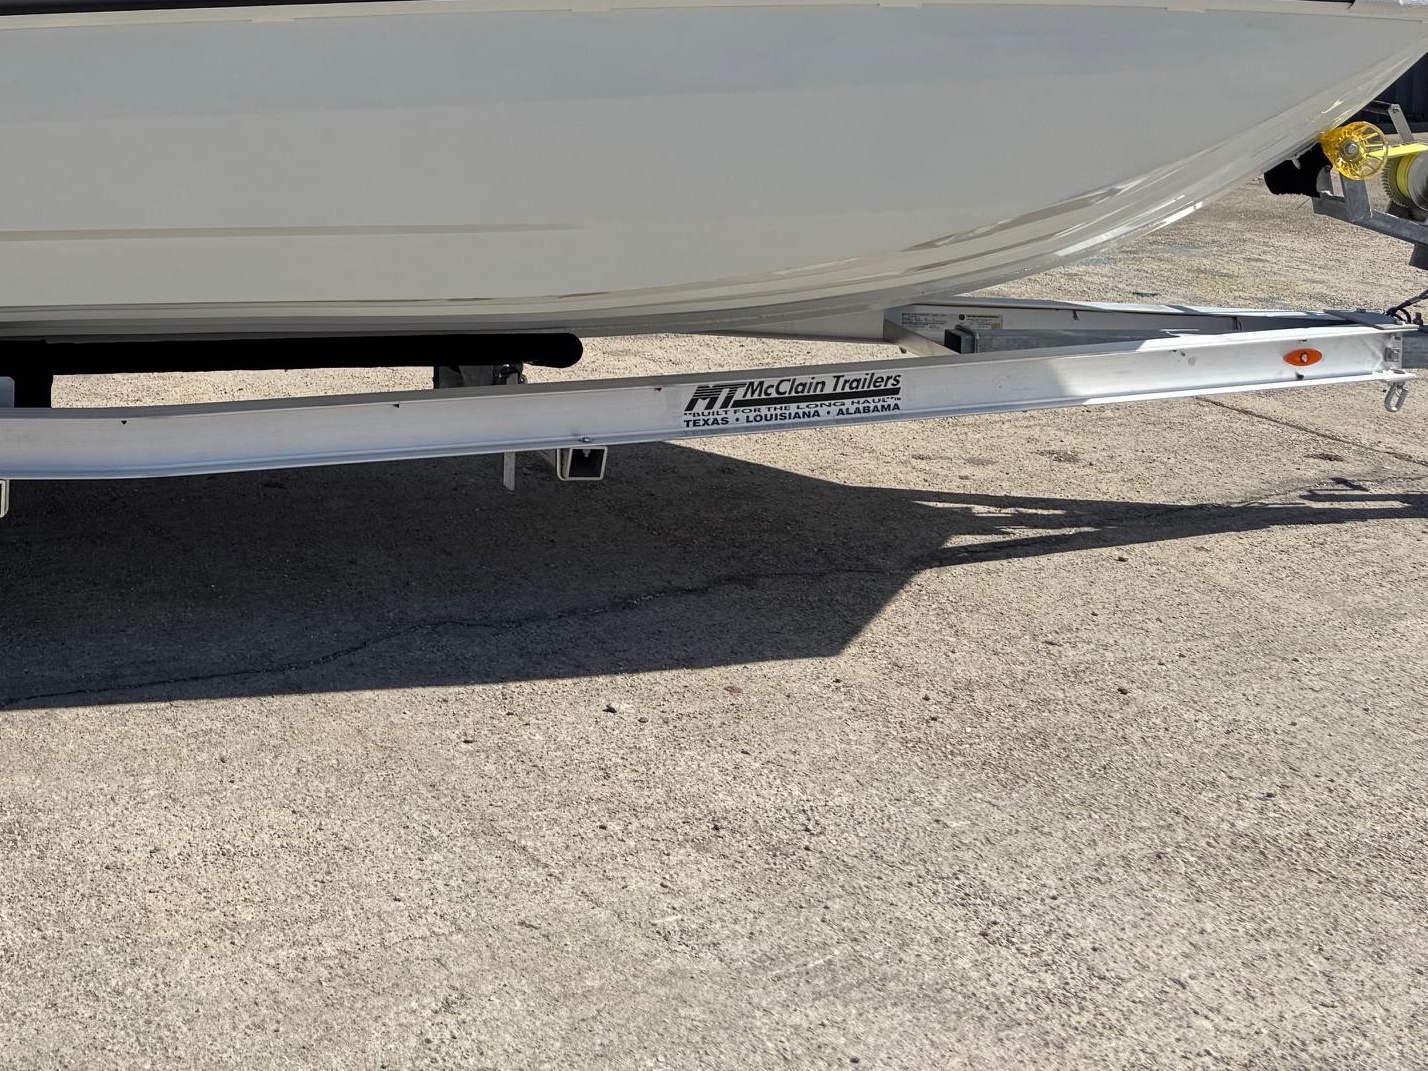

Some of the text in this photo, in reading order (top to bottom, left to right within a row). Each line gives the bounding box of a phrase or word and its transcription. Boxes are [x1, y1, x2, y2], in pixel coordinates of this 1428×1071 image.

[743, 373, 902, 398] McClain Trailers
[683, 404, 900, 428] TEXAS LOUISIANA ALABAMA
[733, 406, 761, 414] FOR
[765, 404, 791, 412] THE
[796, 400, 846, 410] LONG
